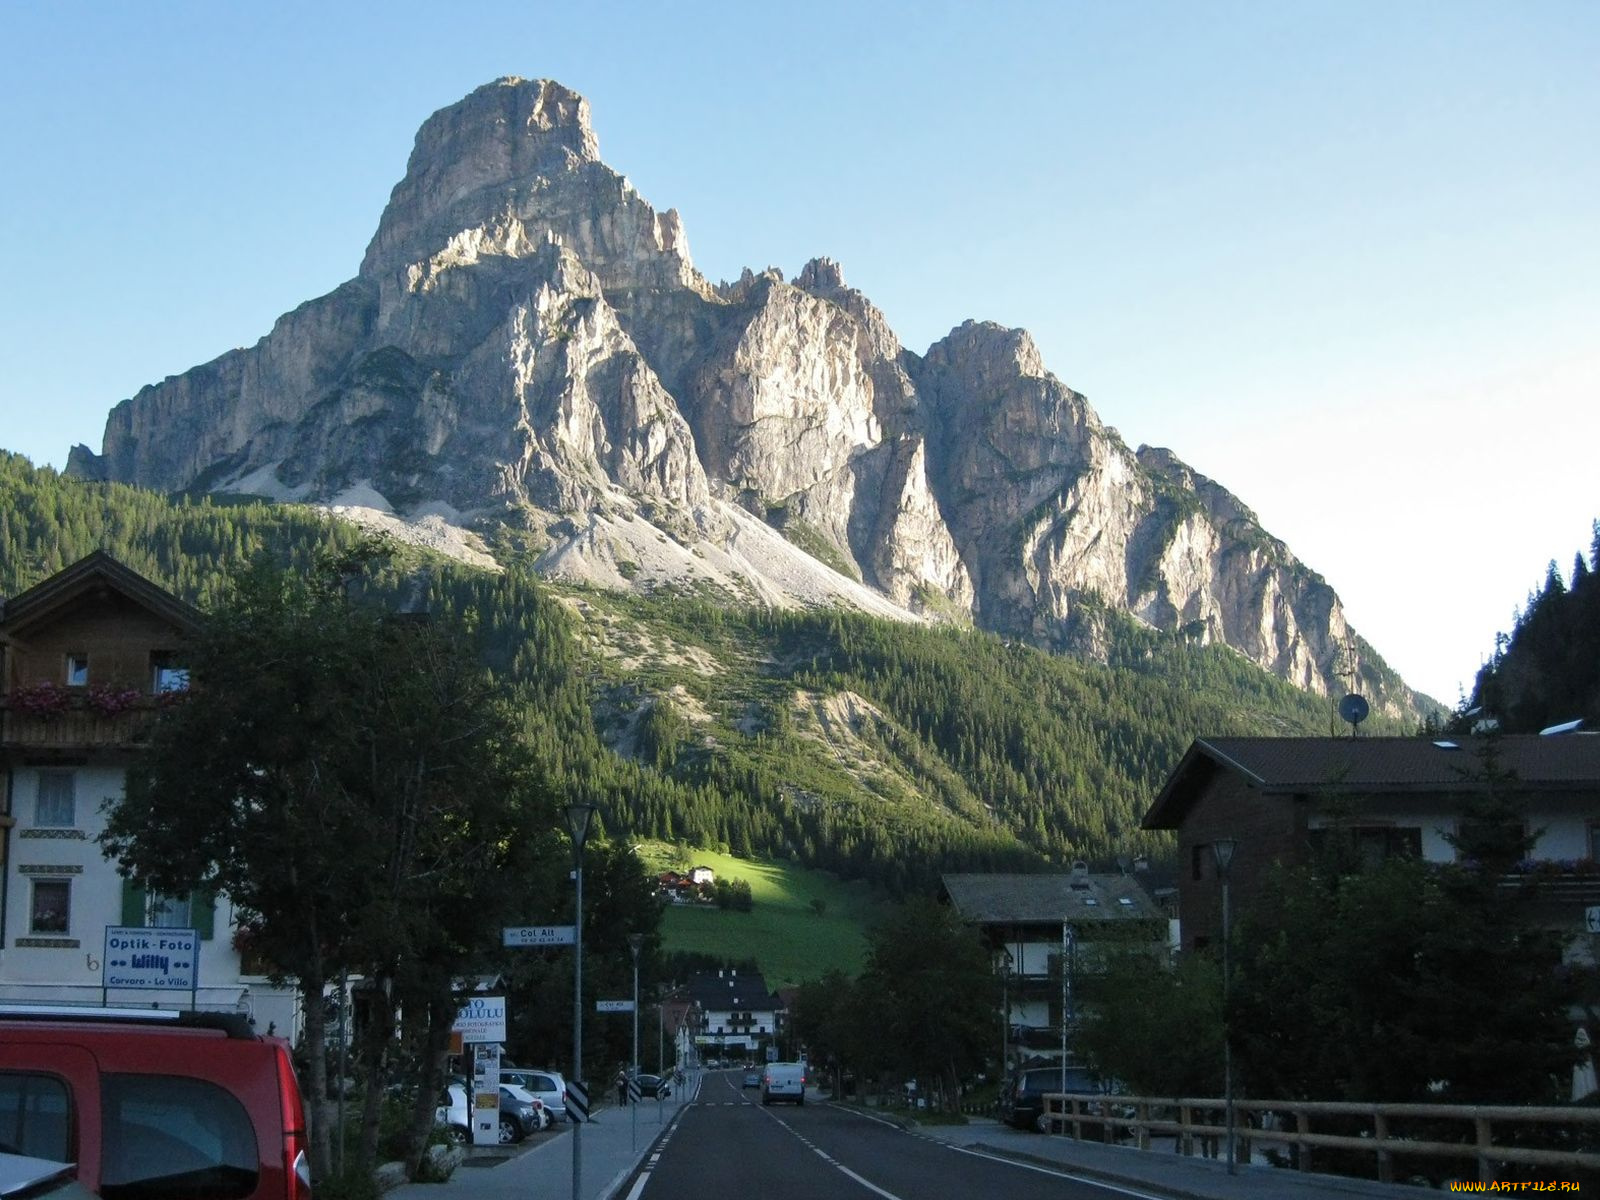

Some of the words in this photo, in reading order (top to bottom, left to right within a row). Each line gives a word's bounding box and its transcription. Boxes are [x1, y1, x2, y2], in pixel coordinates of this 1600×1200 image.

[520, 929, 537, 937] Col
[541, 928, 555, 937] Alt
[110, 938, 150, 950] Optik
[159, 940, 192, 951] Foto
[131, 954, 169, 975] Willy
[458, 1008, 504, 1019] OLULU
